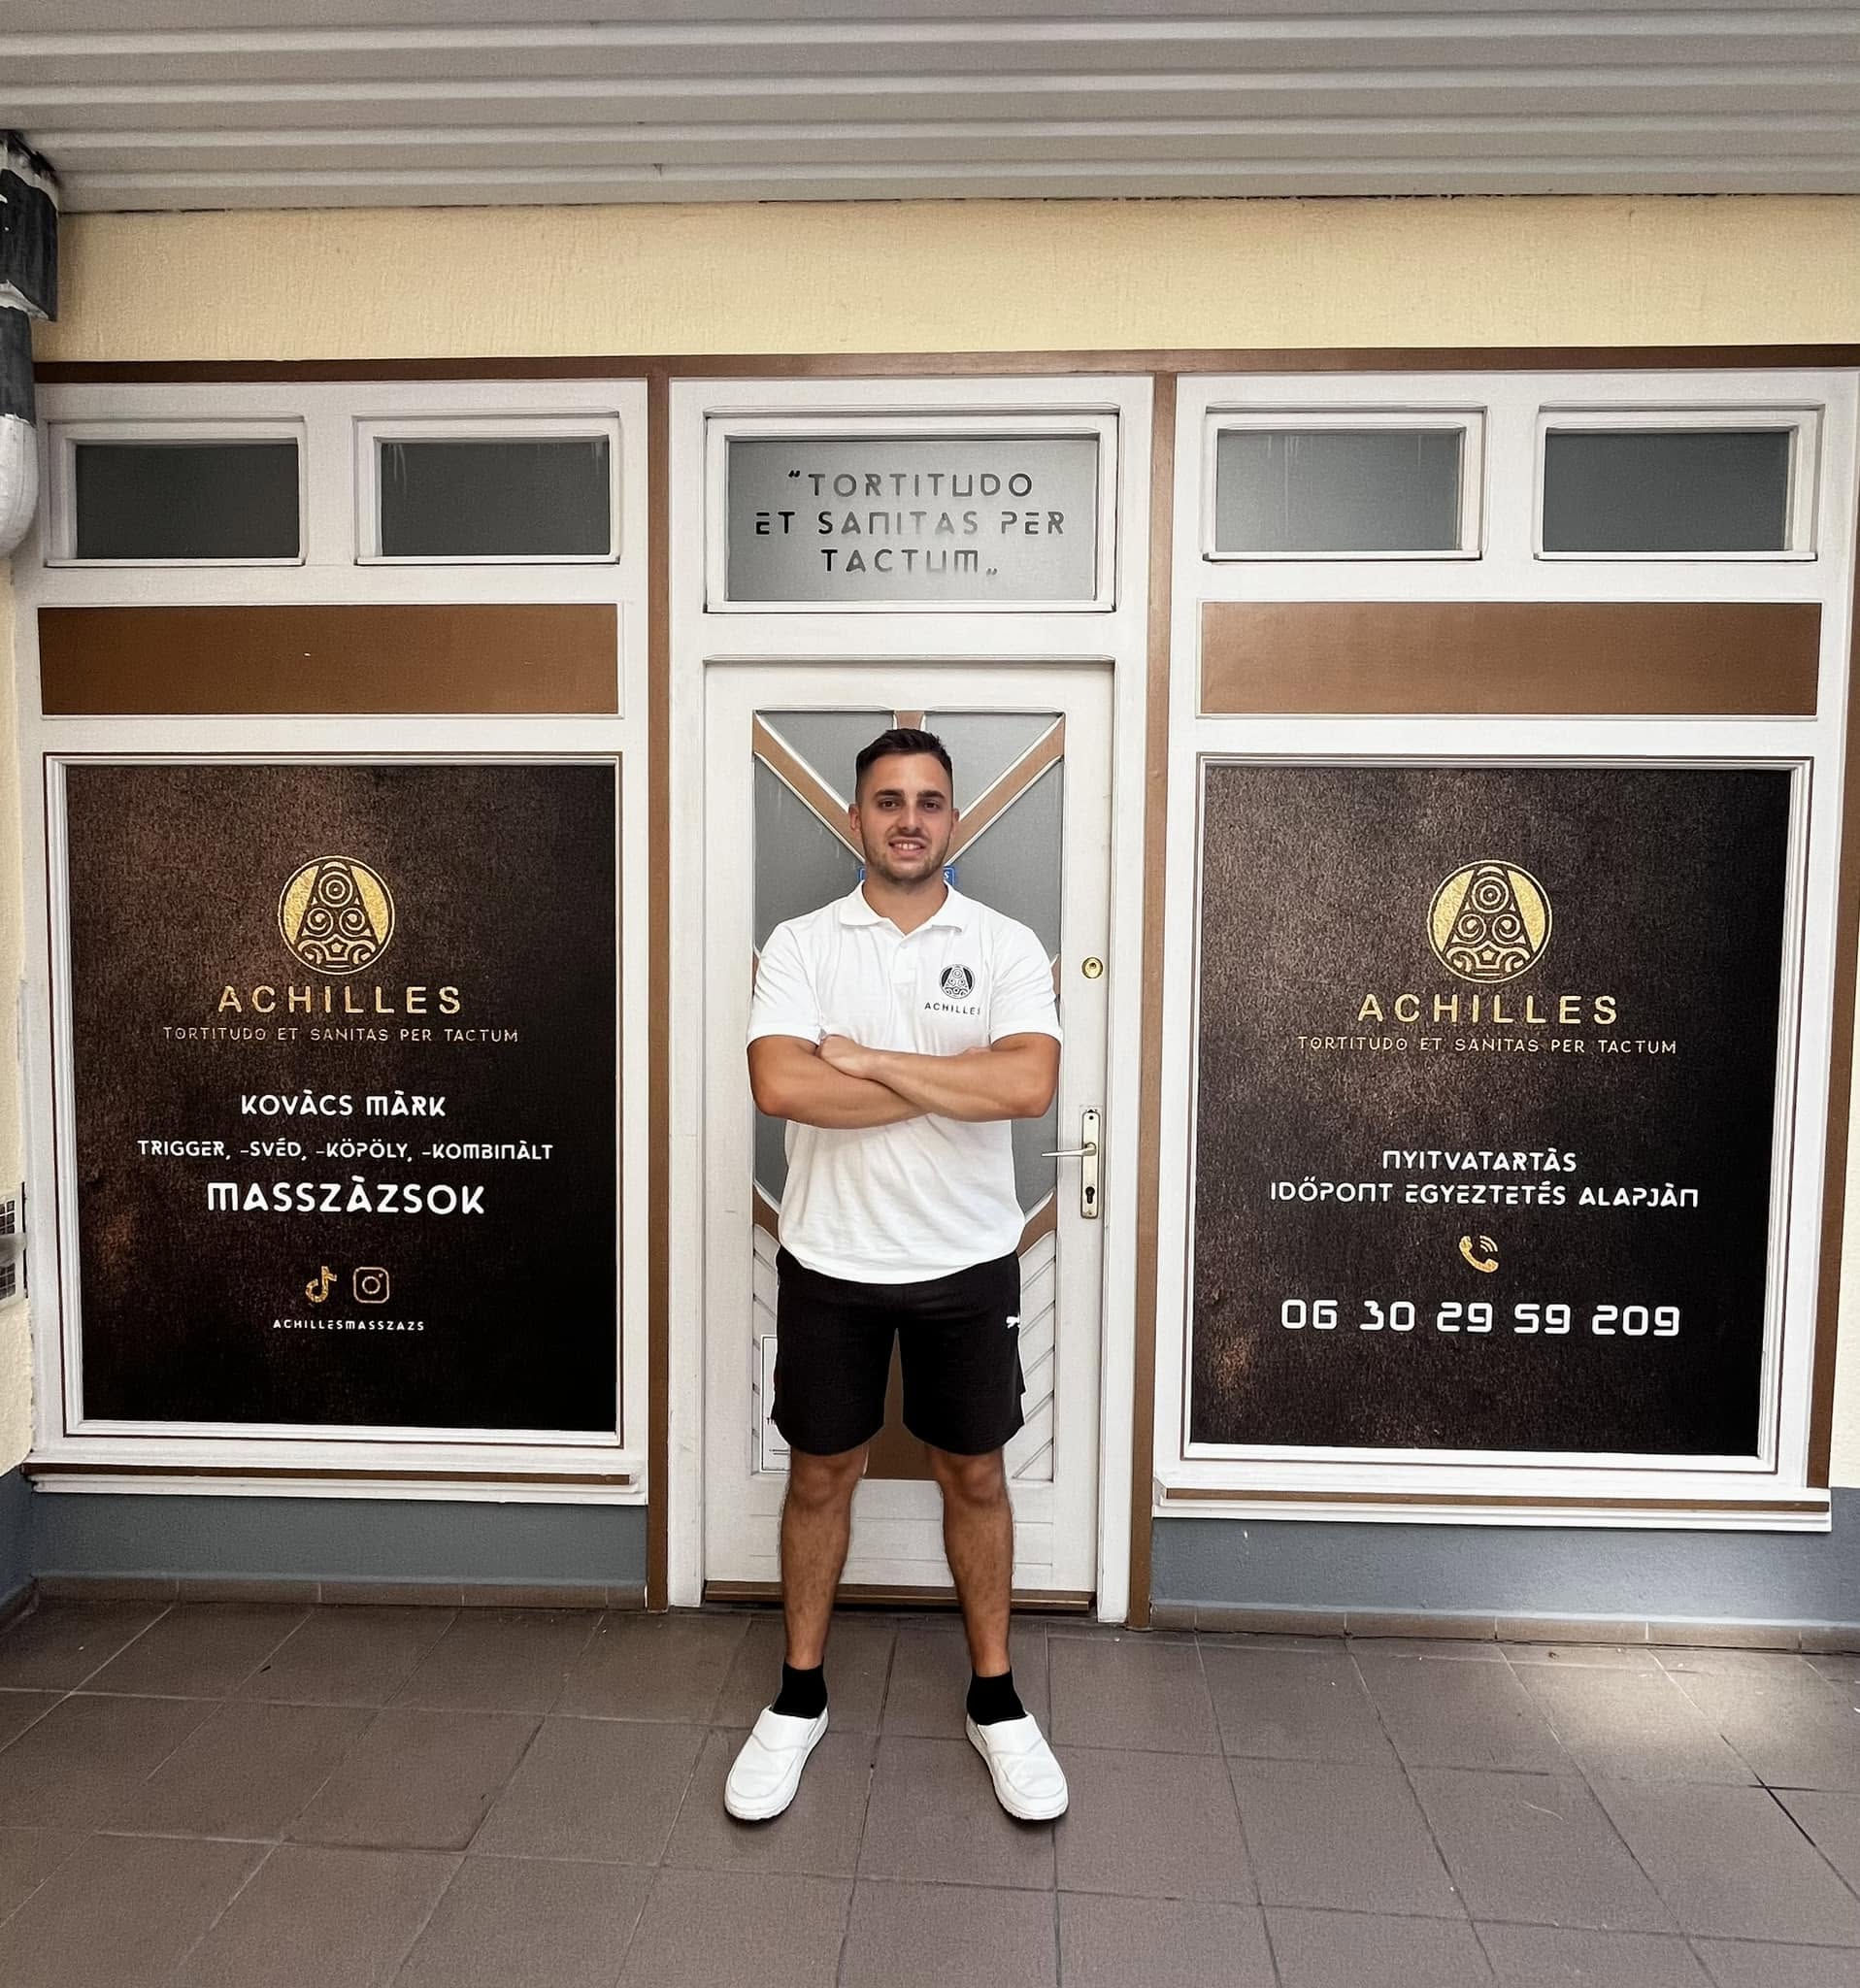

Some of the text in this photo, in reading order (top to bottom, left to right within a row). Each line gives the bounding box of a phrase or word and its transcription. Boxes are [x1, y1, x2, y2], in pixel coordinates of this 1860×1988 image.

[755, 511, 1065, 536] ET SANITAS PER
[217, 985, 461, 1014] ACHILLES
[1357, 993, 1617, 1025] ACHILLES
[163, 1026, 518, 1044] TORTITUDO ET SANITAS PER TACTUM
[1298, 1036, 1677, 1055] TORTITUDO ET SANITAS PER TACTUM
[137, 1140, 231, 1161] TRIGGER,
[1405, 1180, 1566, 1206] EGYEZTETÉS
[273, 1318, 425, 1331] ACHILLESMASSZAZS
[1280, 1299, 1680, 1337] 06 30 29 59 209
